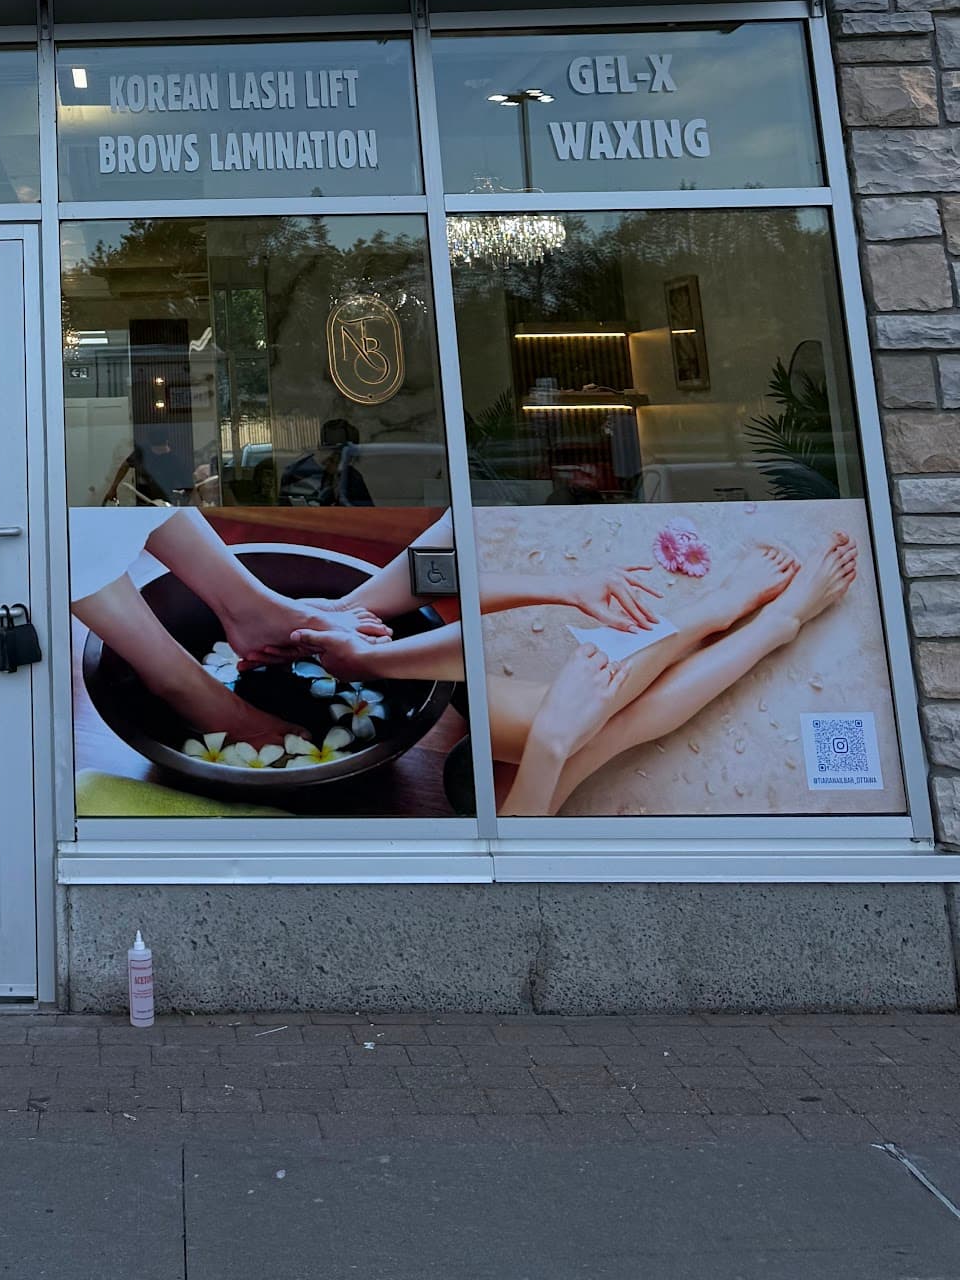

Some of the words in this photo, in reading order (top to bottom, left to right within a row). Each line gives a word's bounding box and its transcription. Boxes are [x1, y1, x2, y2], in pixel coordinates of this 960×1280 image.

[109, 72, 220, 112] KOREAN
[228, 71, 294, 109] LASH
[305, 70, 359, 108] LIFT
[568, 54, 678, 95] GEL-X
[98, 133, 200, 174] BROWS
[209, 129, 378, 171] LAMINATION
[548, 119, 711, 160] WAXING
